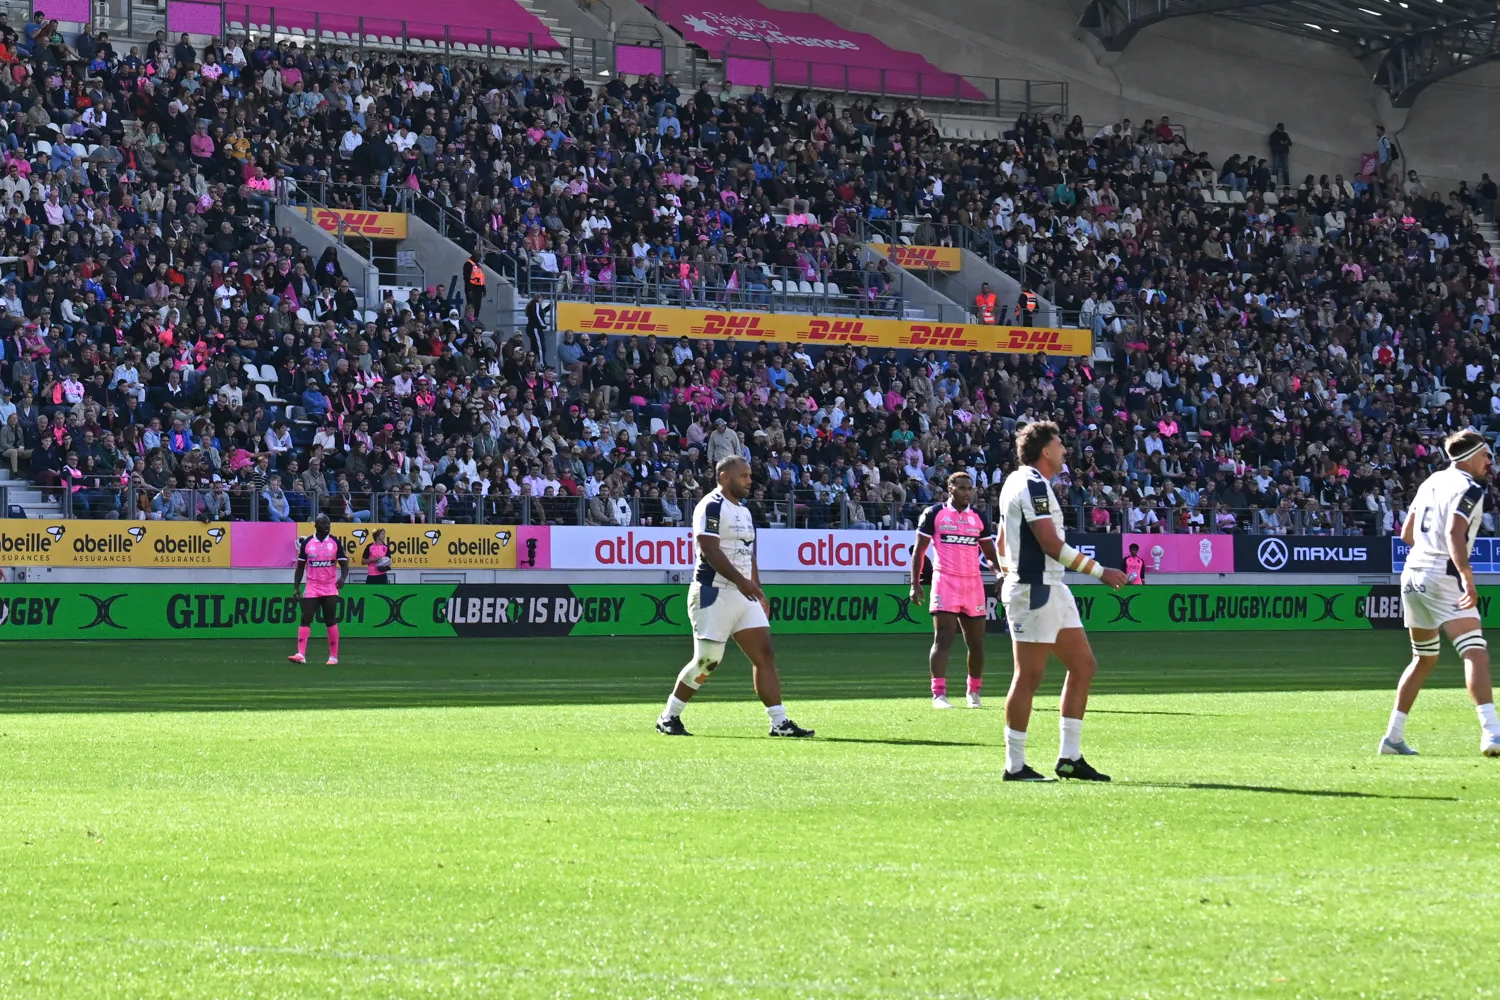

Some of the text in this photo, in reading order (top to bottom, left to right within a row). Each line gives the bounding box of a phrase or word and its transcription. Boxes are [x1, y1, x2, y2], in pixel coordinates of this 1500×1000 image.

[315, 211, 382, 234] DHL
[886, 247, 940, 267] DHL
[593, 309, 1063, 351] DHL DHL DHL DHL DHL
[73, 533, 133, 553] abeille
[154, 534, 213, 554] abeille
[385, 536, 429, 555] beille
[448, 537, 500, 556] abeille
[595, 532, 694, 565] atlanti
[798, 534, 907, 566] atlantic
[946, 535, 978, 545] DHL
[1293, 547, 1367, 561] MAXUS
[166, 594, 366, 629] GILRUGBCOM
[433, 597, 626, 624] GILBERT IS RUGBY
[769, 597, 878, 621] RUGBY.COM
[1168, 594, 1307, 623] GILRUGBY.COM
[1355, 597, 1404, 619] GILBE
